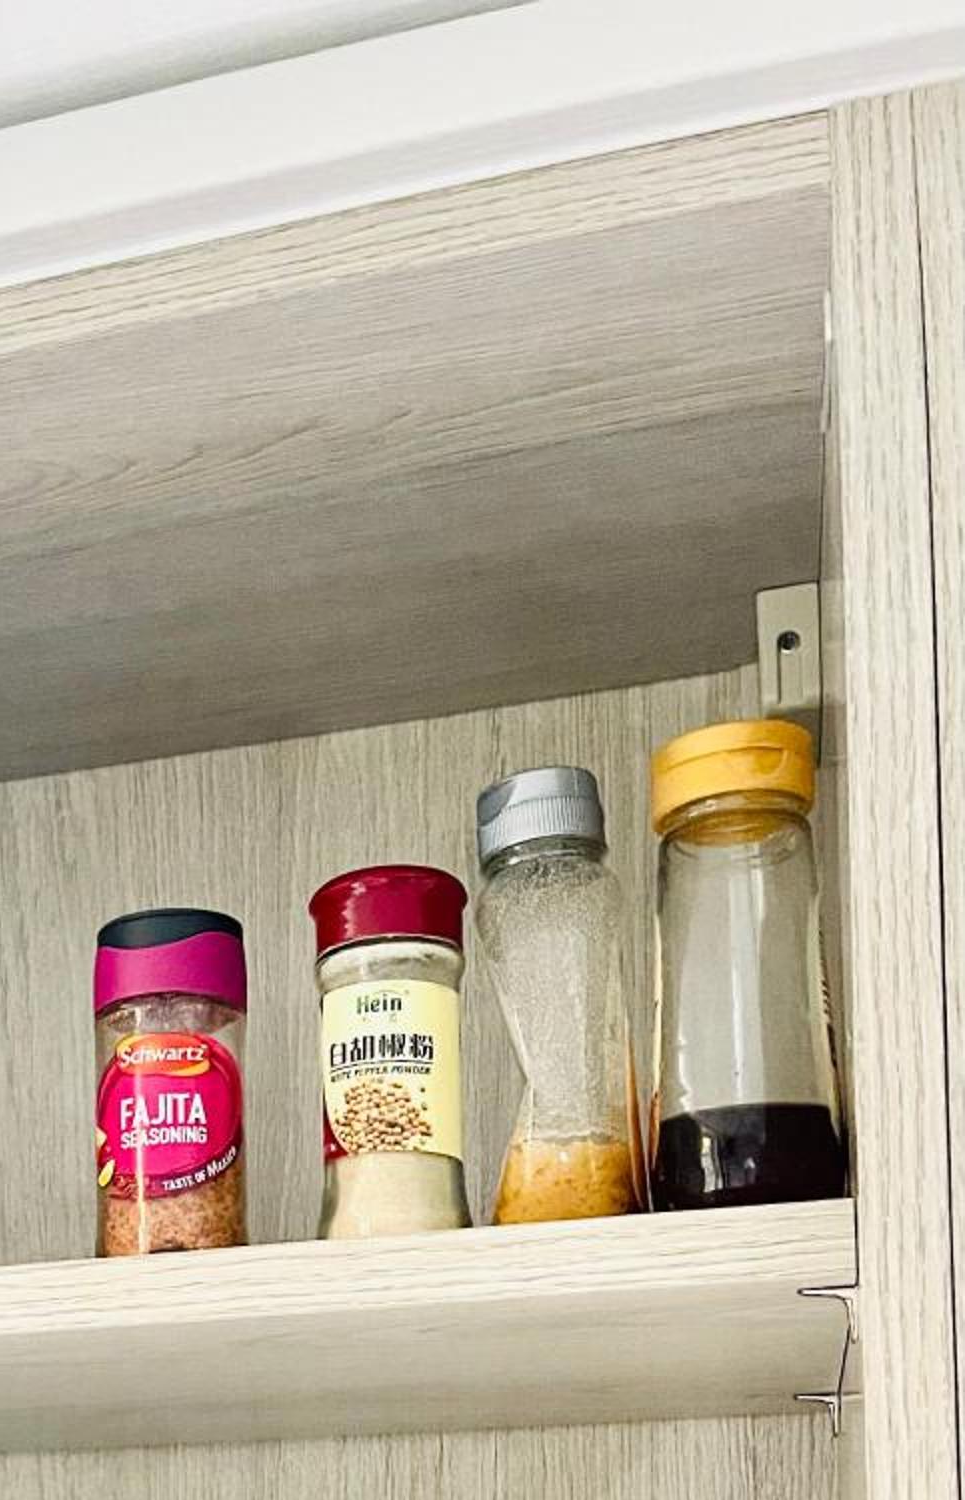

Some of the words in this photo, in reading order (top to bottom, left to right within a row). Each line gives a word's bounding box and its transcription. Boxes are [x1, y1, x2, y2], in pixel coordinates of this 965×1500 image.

[356, 993, 402, 1014] Hein
[119, 1045, 204, 1068] Schwartz
[330, 1033, 434, 1068] 白胡椒粉
[120, 1093, 207, 1131] FAJITA
[120, 1125, 208, 1149] SEASONING
[162, 1175, 195, 1191] TASTE
[194, 1169, 207, 1183] OF
